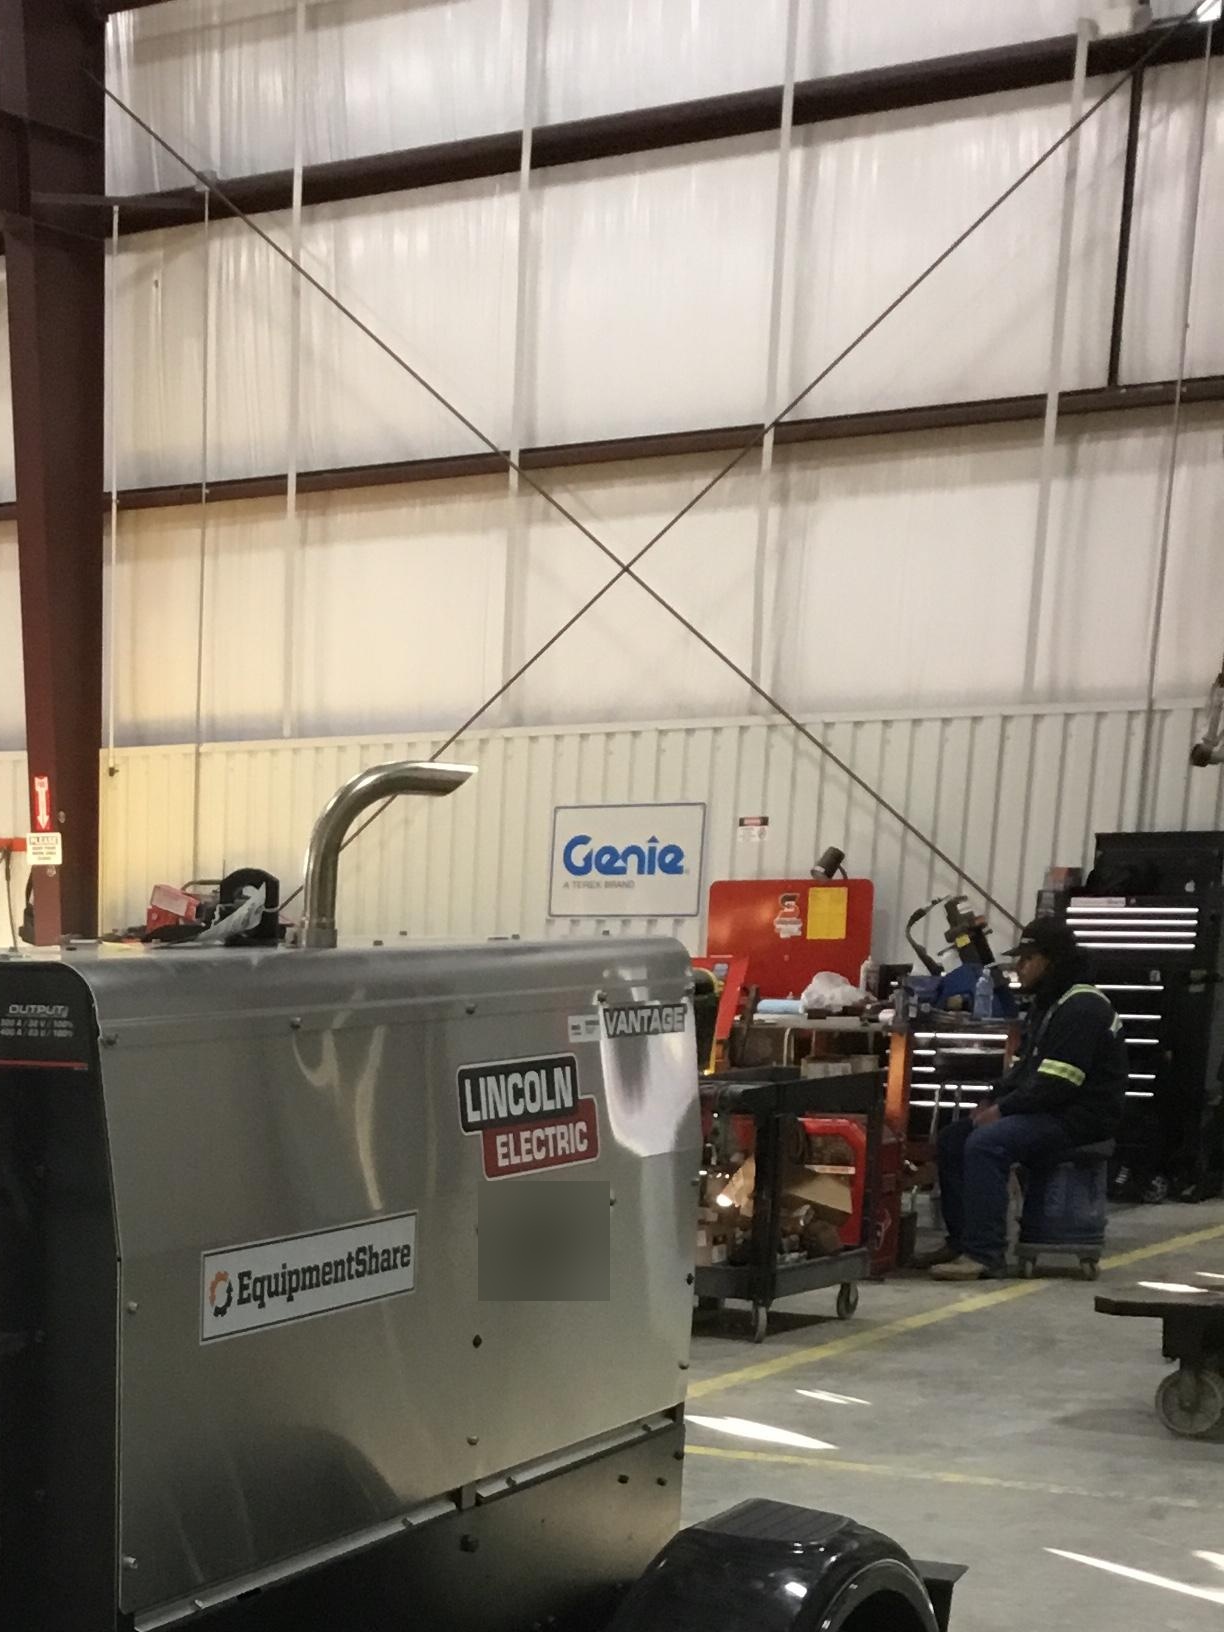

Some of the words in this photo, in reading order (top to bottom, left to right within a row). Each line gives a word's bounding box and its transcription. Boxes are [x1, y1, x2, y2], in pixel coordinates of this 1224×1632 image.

[562, 834, 685, 877] Genie
[8, 1003, 65, 1015] OUTPUT
[605, 1006, 685, 1036] VANTAGE
[464, 1065, 574, 1123] LINCOLN
[496, 1120, 588, 1168] ELECTRIC
[236, 1243, 412, 1309] EquipmentShare
